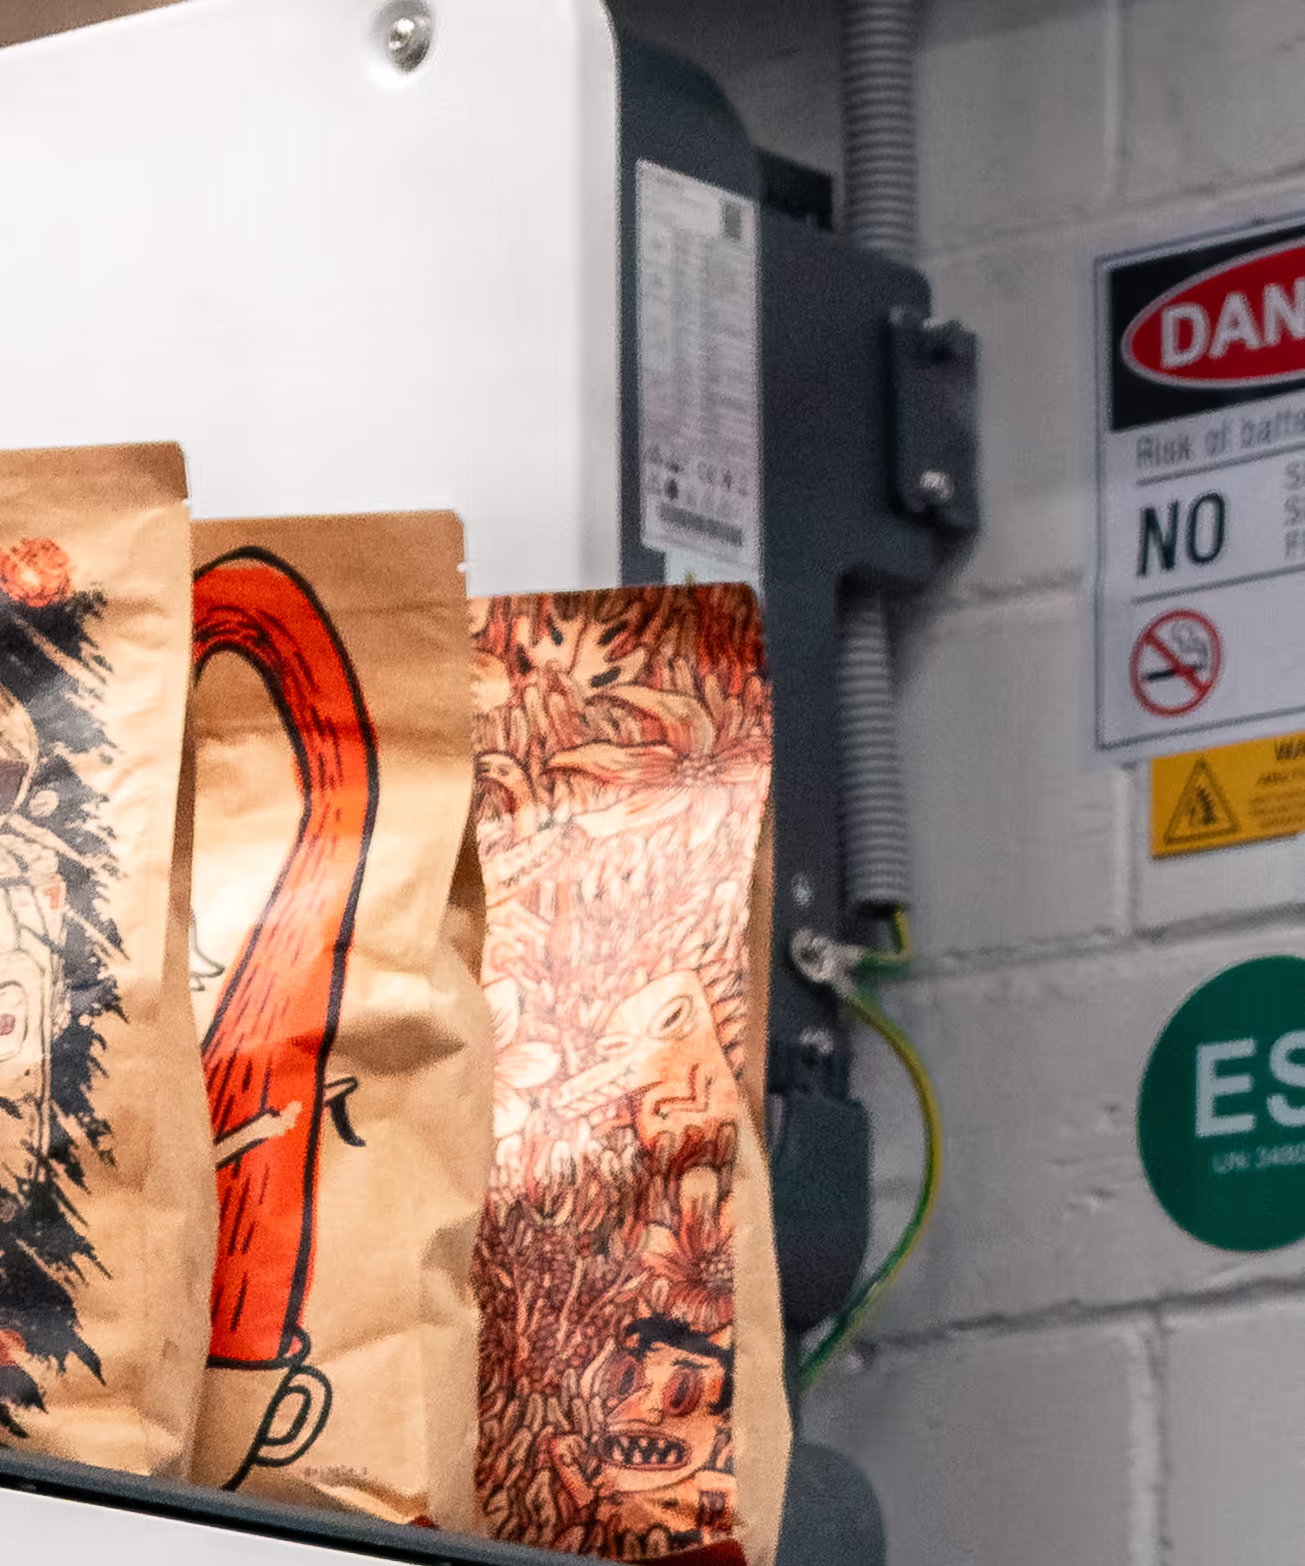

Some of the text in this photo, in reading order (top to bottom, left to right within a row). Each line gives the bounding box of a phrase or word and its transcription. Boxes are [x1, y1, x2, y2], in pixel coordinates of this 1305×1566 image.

[1160, 275, 1305, 370] DAN
[1136, 433, 1190, 468] Risk
[1136, 492, 1225, 577] NO
[1195, 1029, 1305, 1138] ES
